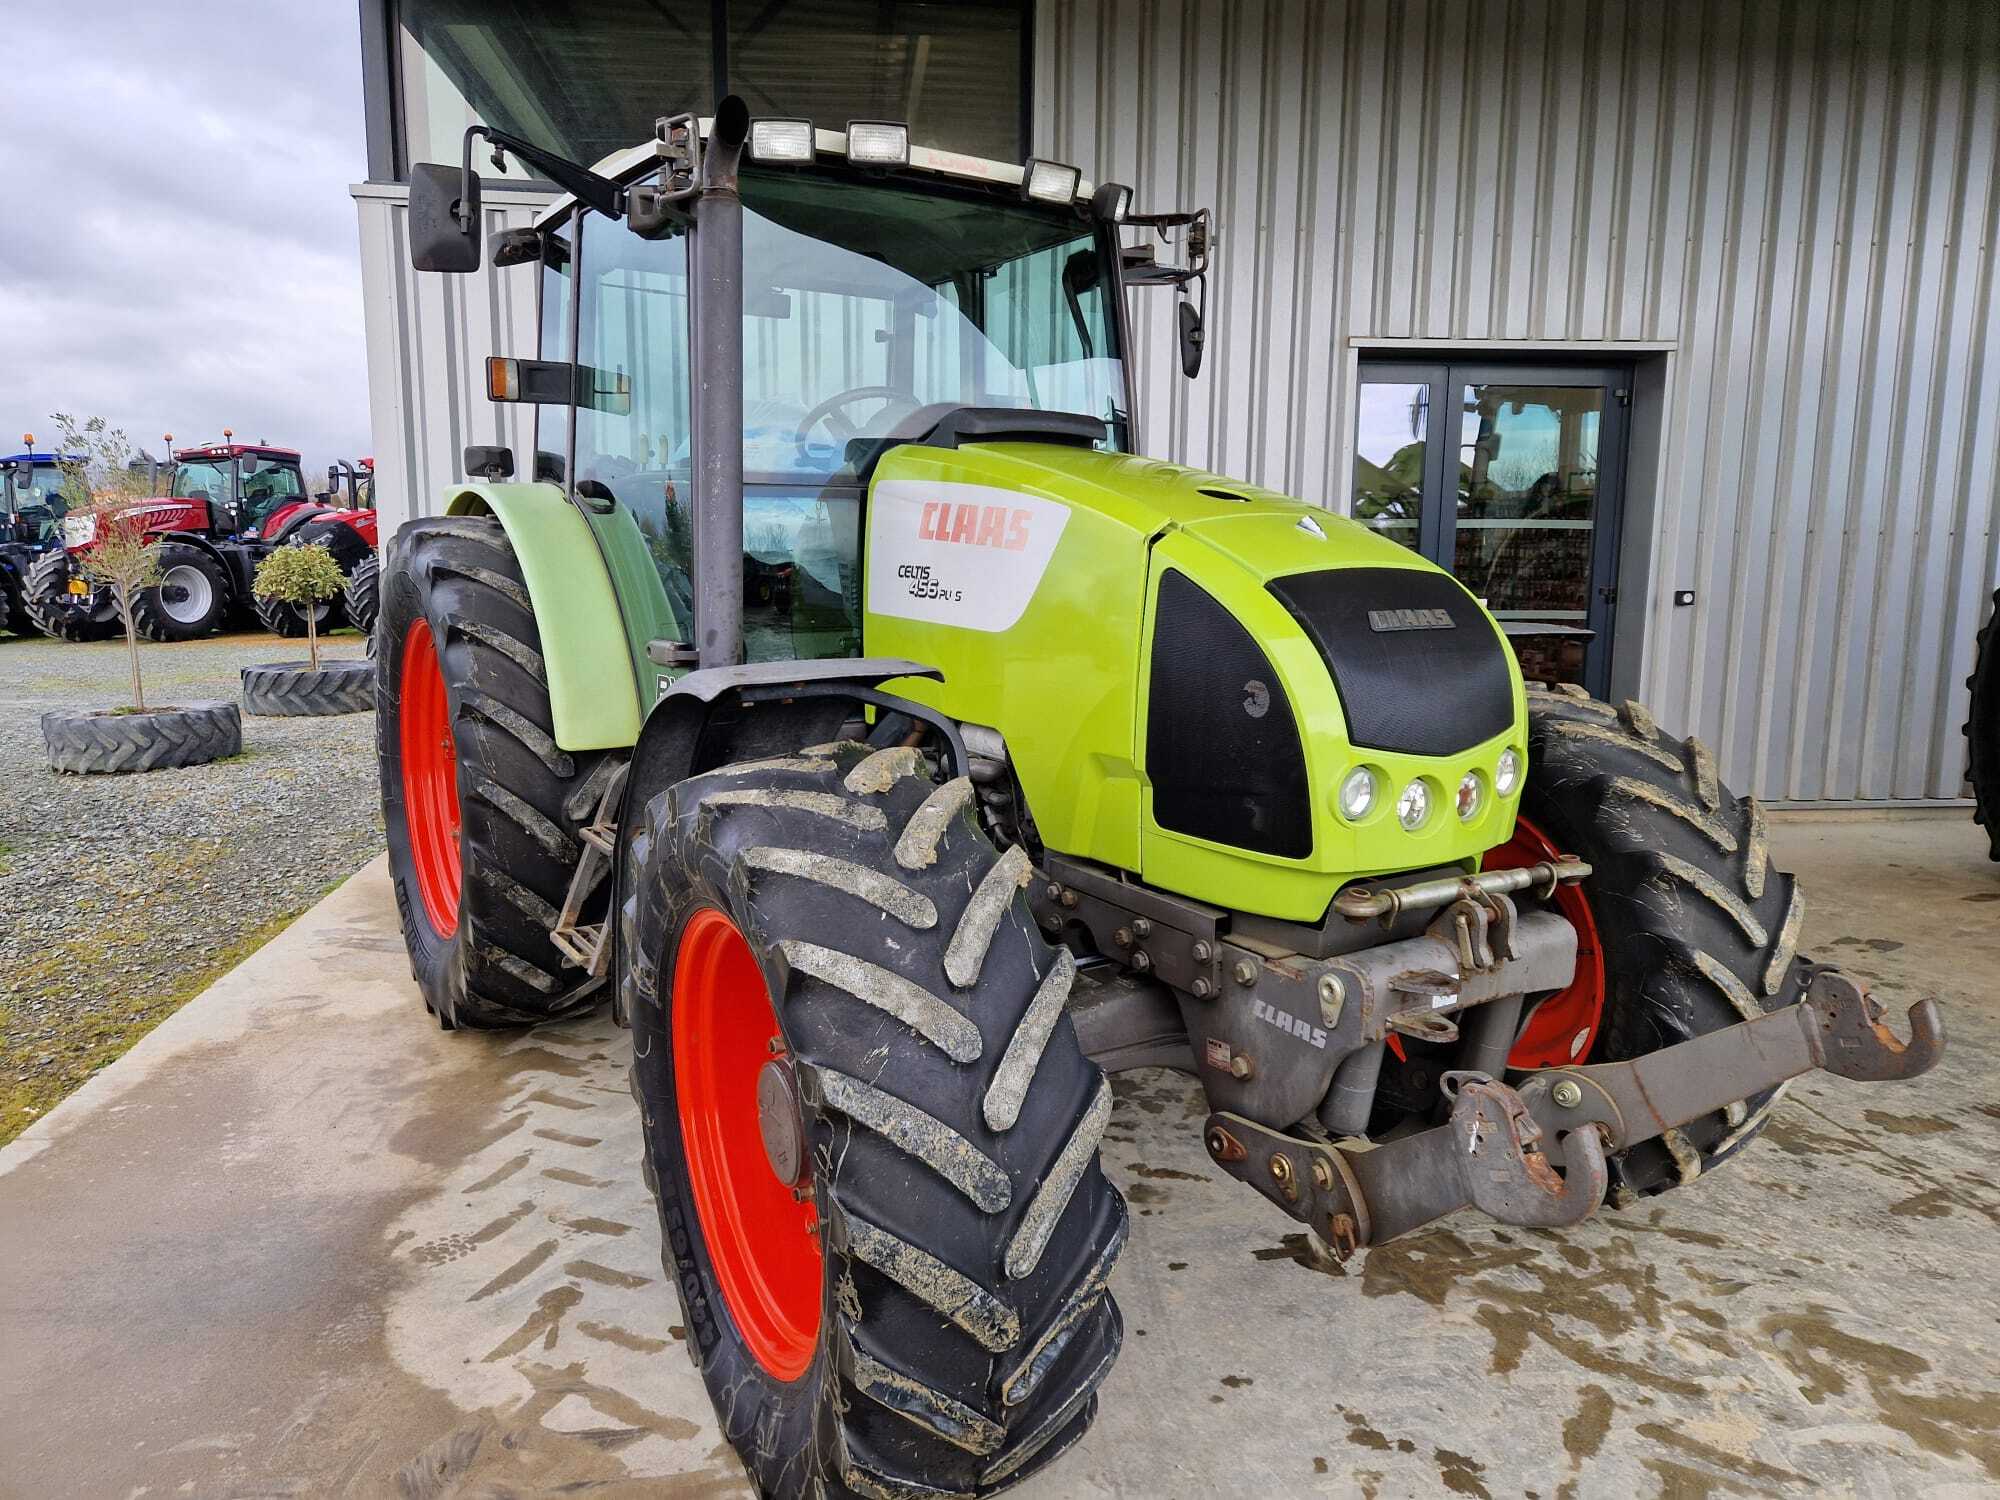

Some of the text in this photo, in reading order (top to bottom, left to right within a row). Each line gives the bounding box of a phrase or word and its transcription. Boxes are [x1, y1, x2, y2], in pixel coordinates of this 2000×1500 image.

[918, 502, 1033, 552] CLAAS
[898, 564, 931, 580] CELTIS
[909, 578, 939, 599] 456
[1253, 999, 1328, 1049] CLAAS
